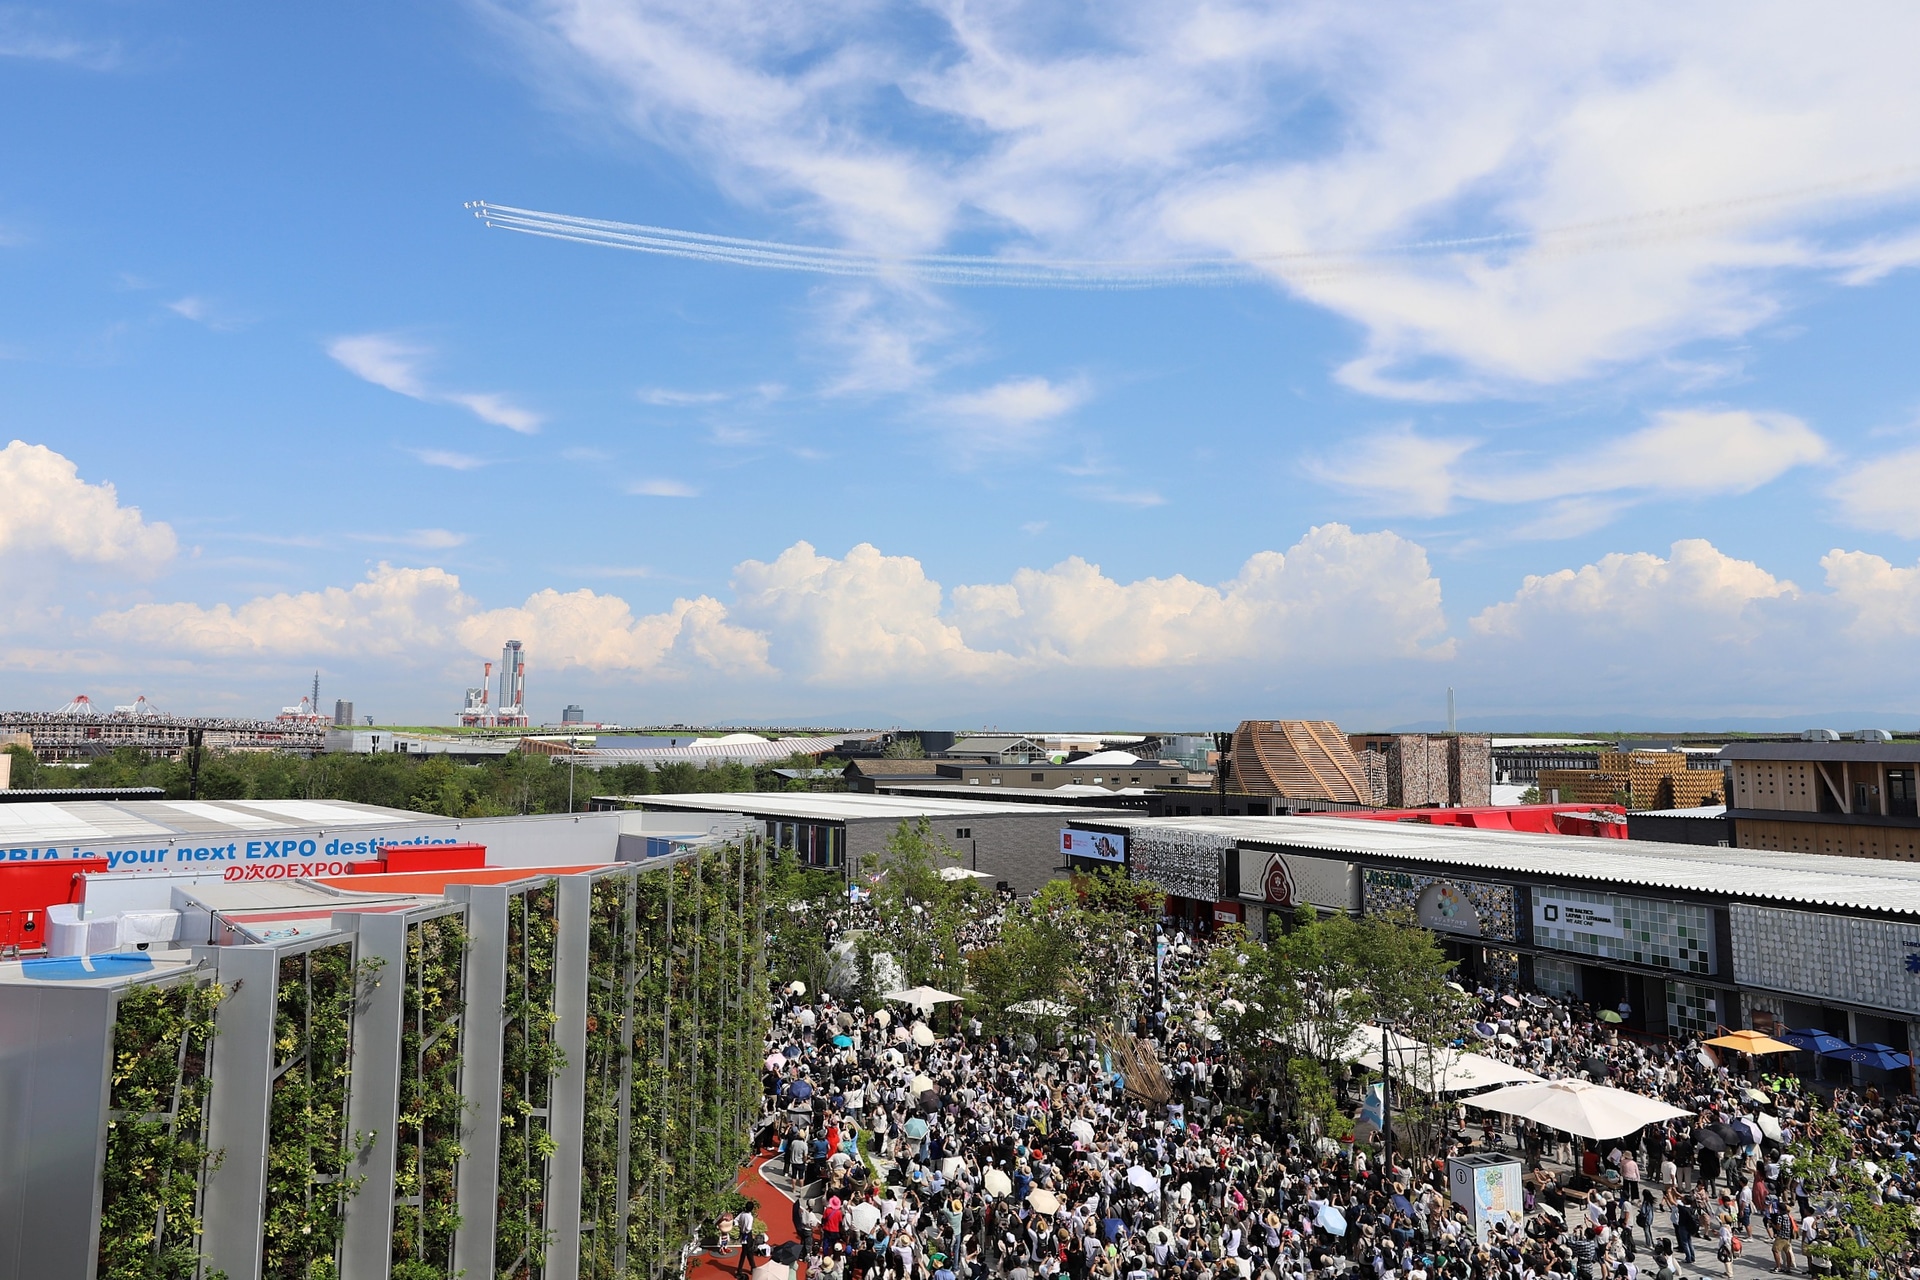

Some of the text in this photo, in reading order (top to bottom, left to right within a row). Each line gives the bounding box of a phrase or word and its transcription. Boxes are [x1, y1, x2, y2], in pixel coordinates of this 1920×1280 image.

[107, 849, 169, 869] your
[177, 842, 237, 862] next
[246, 839, 317, 860] EXPO
